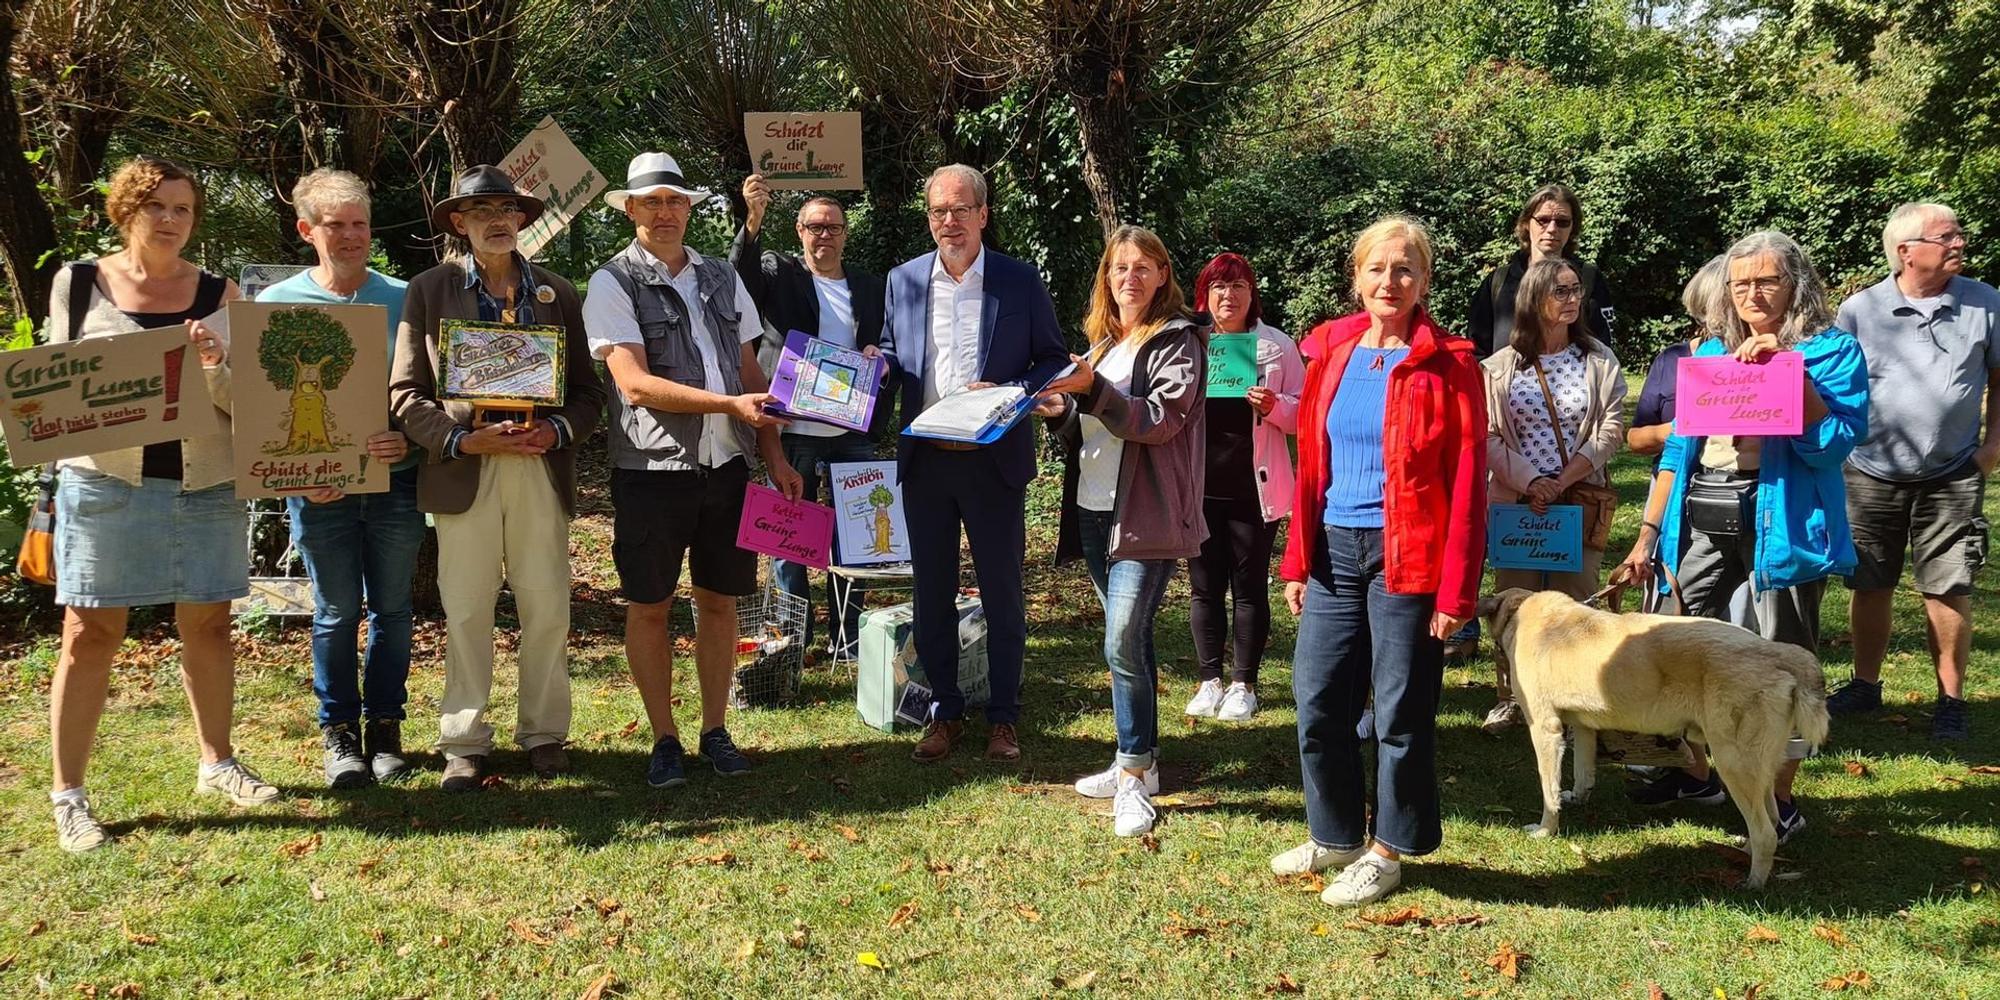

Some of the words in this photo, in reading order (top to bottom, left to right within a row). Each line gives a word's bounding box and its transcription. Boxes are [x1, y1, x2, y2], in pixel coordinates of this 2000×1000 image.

[764, 121, 824, 138] Schützt
[786, 139, 807, 151] die
[509, 147, 538, 182] chützt
[760, 149, 801, 172] Grüne
[806, 149, 845, 172] Lunge
[5, 352, 104, 389] Grüne
[1711, 370, 1767, 386] Schützt
[1208, 373, 1243, 387] Lunge
[1695, 389, 1758, 407] Grüne
[65, 412, 97, 429] nicht
[1728, 405, 1783, 422] Lunge
[315, 458, 342, 473] die
[754, 516, 798, 539] Grüne
[1518, 515, 1561, 531] Schützt
[778, 537, 818, 558] Lunge
[1501, 532, 1548, 547] Grüne
[1528, 547, 1569, 561] Lunge
